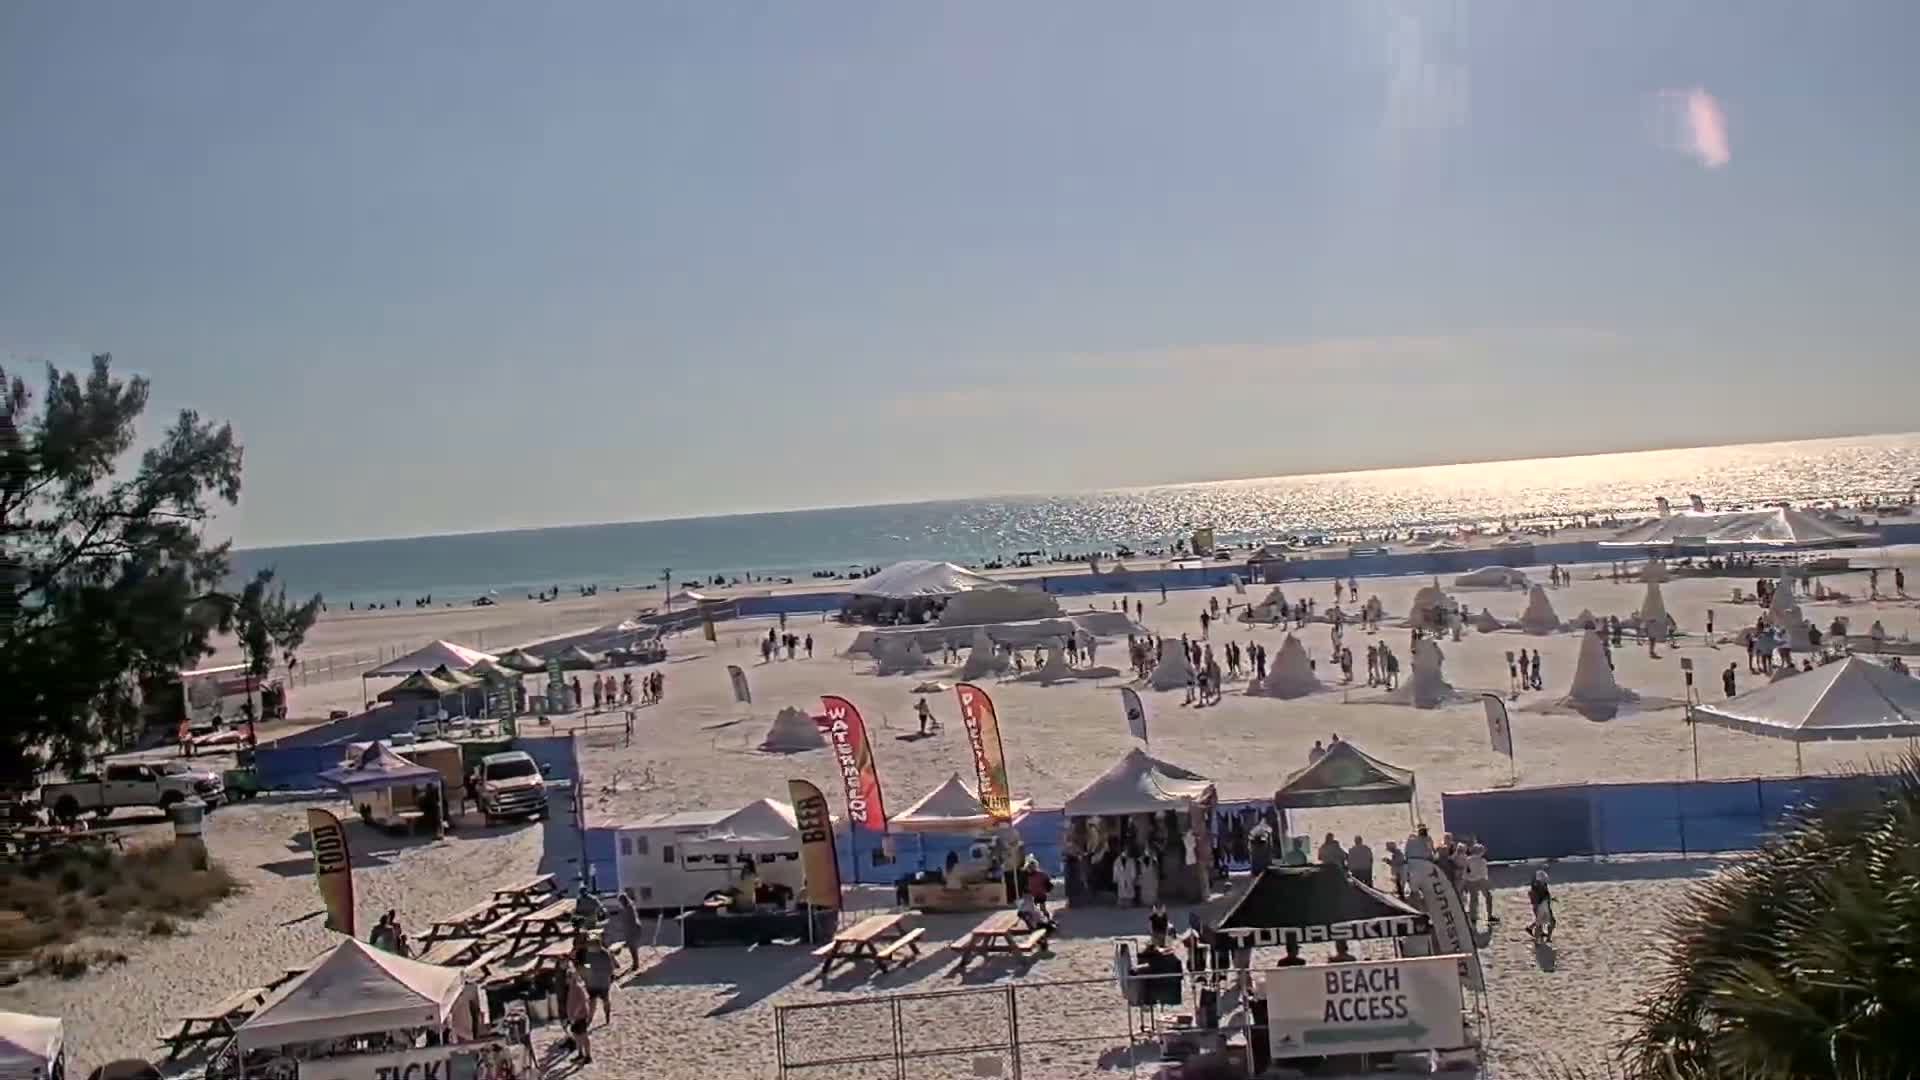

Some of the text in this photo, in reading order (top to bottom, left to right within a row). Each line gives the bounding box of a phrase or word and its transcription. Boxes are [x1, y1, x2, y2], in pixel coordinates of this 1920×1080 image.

[830, 707, 867, 823] WATERMELON
[798, 795, 826, 843] BEER
[312, 825, 345, 875] FOOD
[1227, 917, 1414, 947] TUNASKIN
[1325, 967, 1400, 994] BEACH
[1323, 995, 1408, 1023] ACCESS
